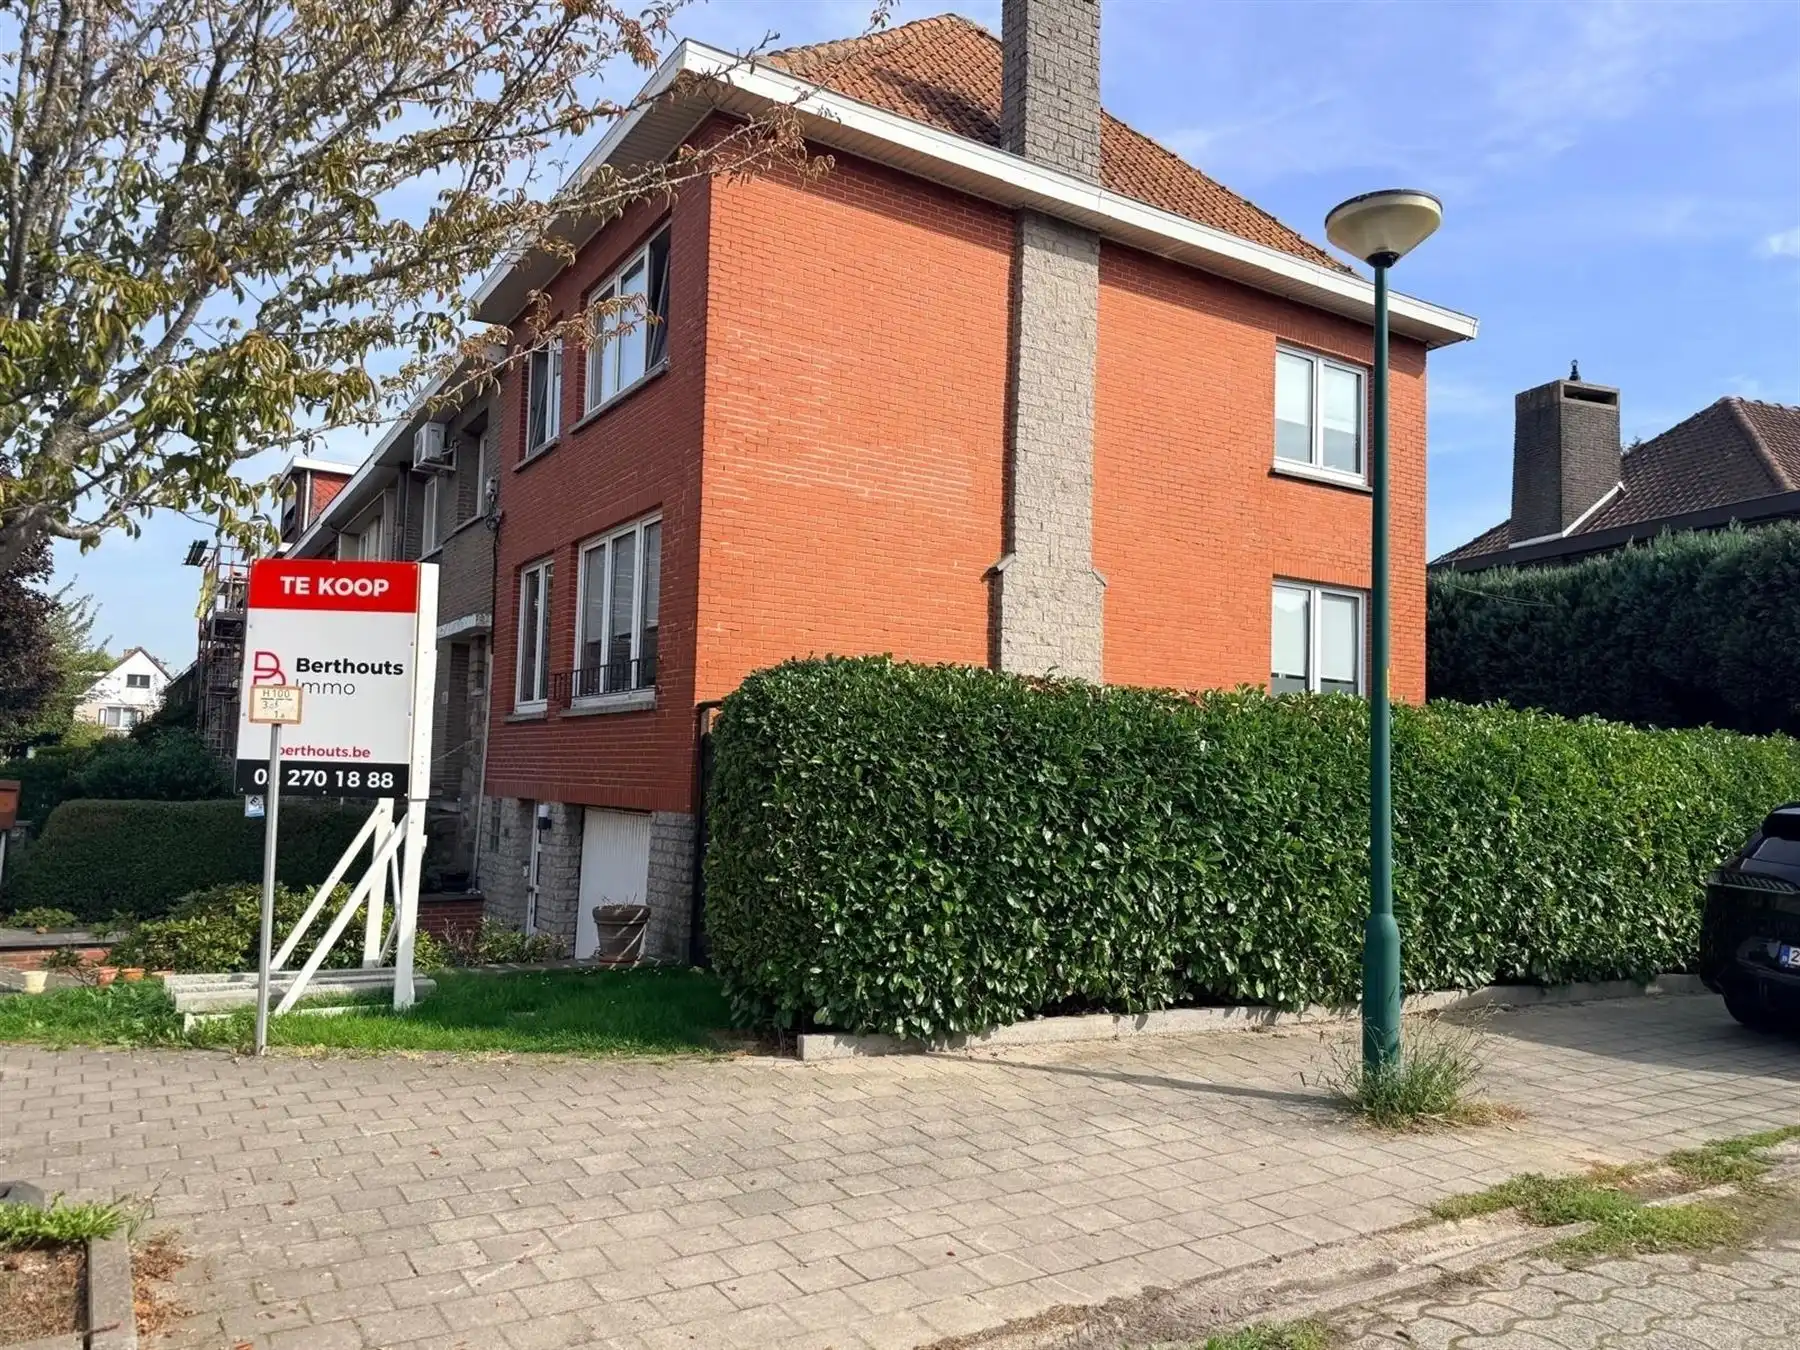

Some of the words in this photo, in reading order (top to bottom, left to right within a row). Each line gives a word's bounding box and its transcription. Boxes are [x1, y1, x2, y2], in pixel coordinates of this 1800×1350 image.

[280, 576, 310, 595] TE
[318, 577, 389, 597] KOOP
[296, 657, 404, 675] Berthouts
[254, 768, 270, 785] 0
[287, 769, 327, 786] 270
[335, 770, 360, 788] 18
[367, 772, 394, 788] 88
